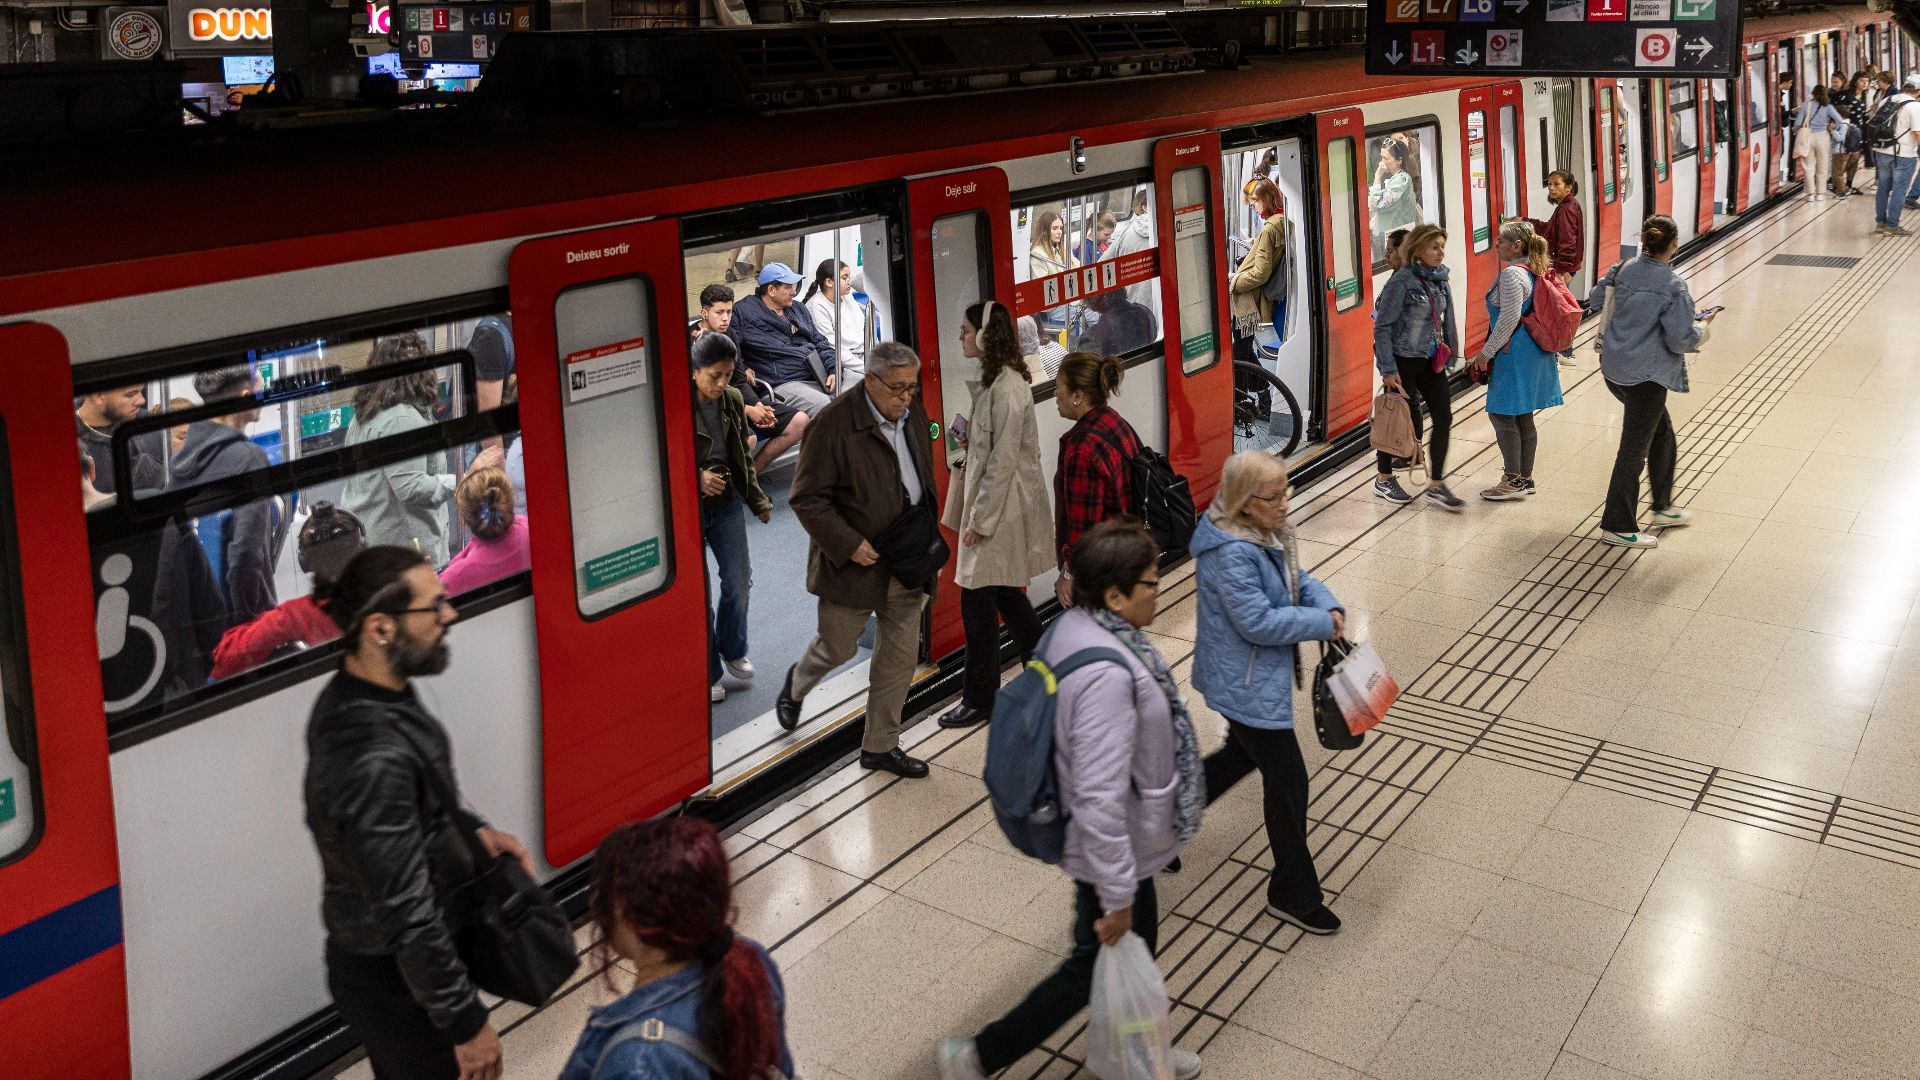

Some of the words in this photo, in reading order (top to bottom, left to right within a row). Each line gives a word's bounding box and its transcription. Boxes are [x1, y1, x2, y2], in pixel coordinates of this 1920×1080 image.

[1426, 0, 1450, 13] L7
[1464, 0, 1492, 13] L6
[483, 12, 495, 25] L6
[500, 12, 511, 25] L7
[422, 40, 428, 51] B
[1413, 42, 1436, 63] L1
[1647, 39, 1664, 57] B
[945, 184, 961, 198] Deje
[962, 181, 977, 194] salir
[567, 250, 602, 263] Deixeu
[604, 243, 630, 257] sortir
